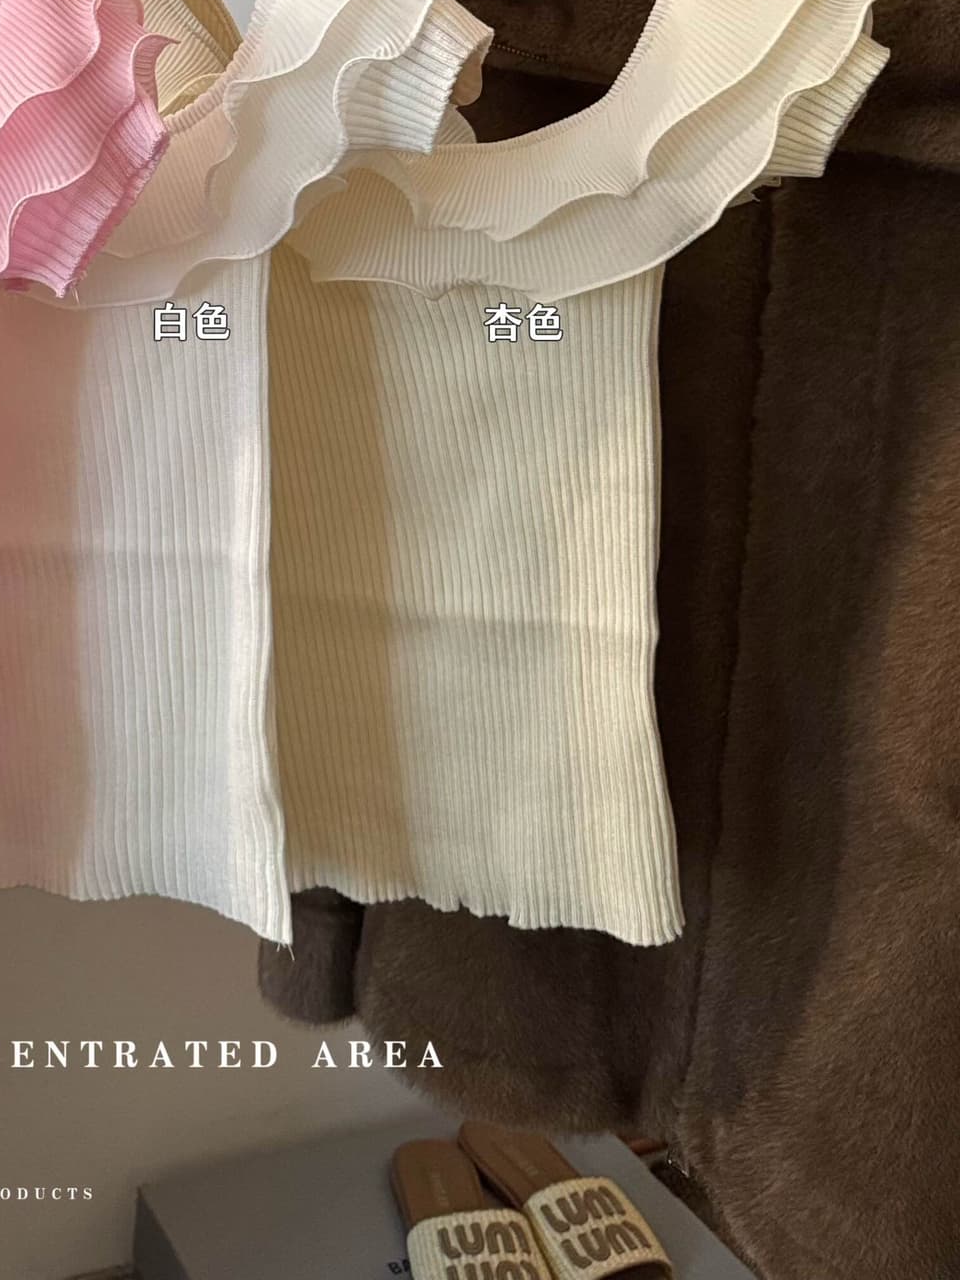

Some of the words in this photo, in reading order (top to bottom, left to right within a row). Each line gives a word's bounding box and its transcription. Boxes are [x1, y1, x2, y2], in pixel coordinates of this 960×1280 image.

[541, 1186, 627, 1234] LUM
[437, 1221, 531, 1259] LUM
[561, 1220, 652, 1269] LUM
